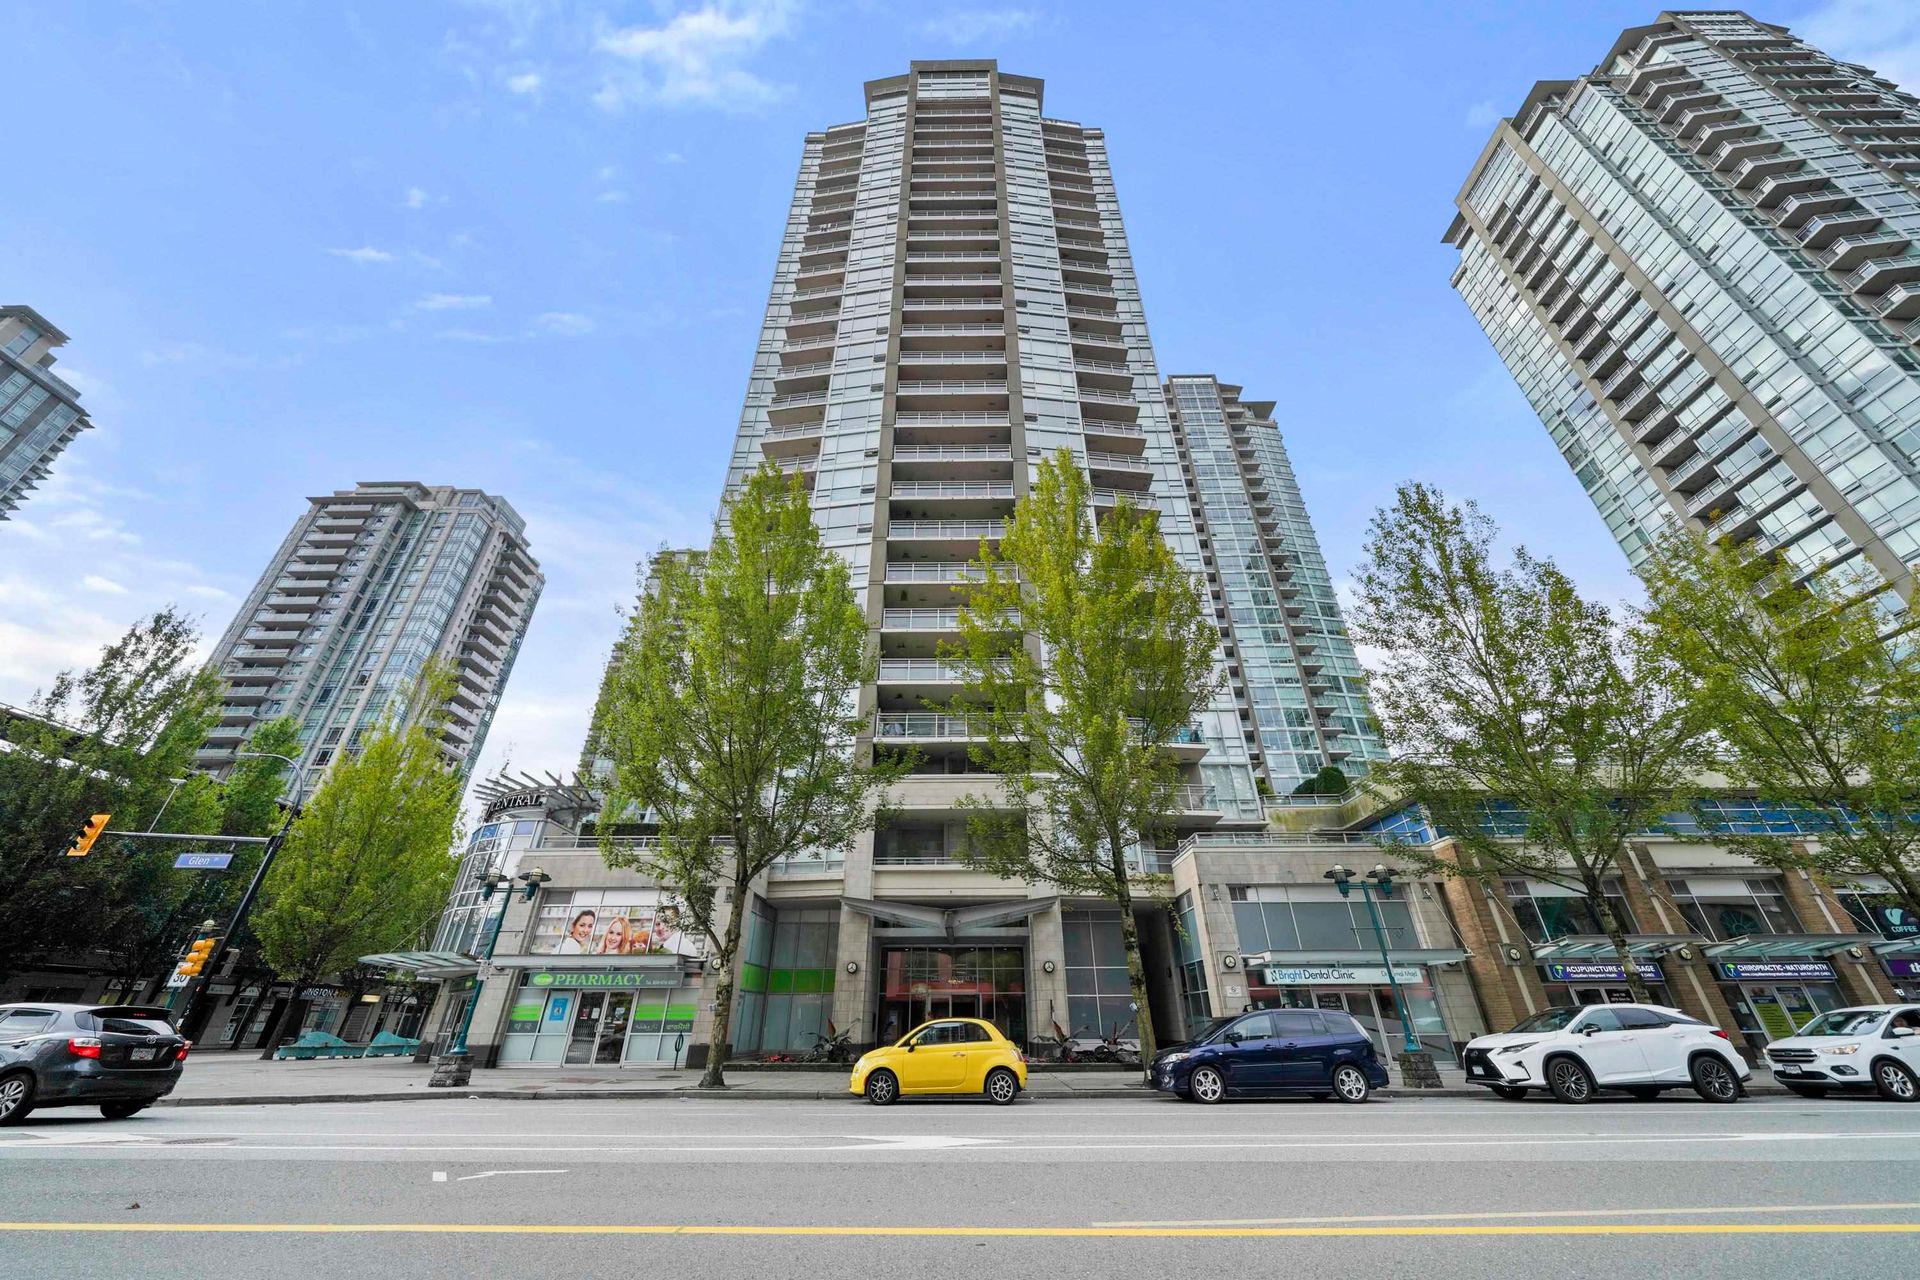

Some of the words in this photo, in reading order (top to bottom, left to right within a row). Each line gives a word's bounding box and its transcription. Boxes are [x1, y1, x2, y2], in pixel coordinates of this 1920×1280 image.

[188, 857, 210, 865] Glen
[173, 971, 187, 982] 30
[554, 974, 644, 985] PHARMACY
[1278, 969, 1302, 982] Bright
[1303, 969, 1330, 980] Dental
[1331, 969, 1356, 980] Clinic
